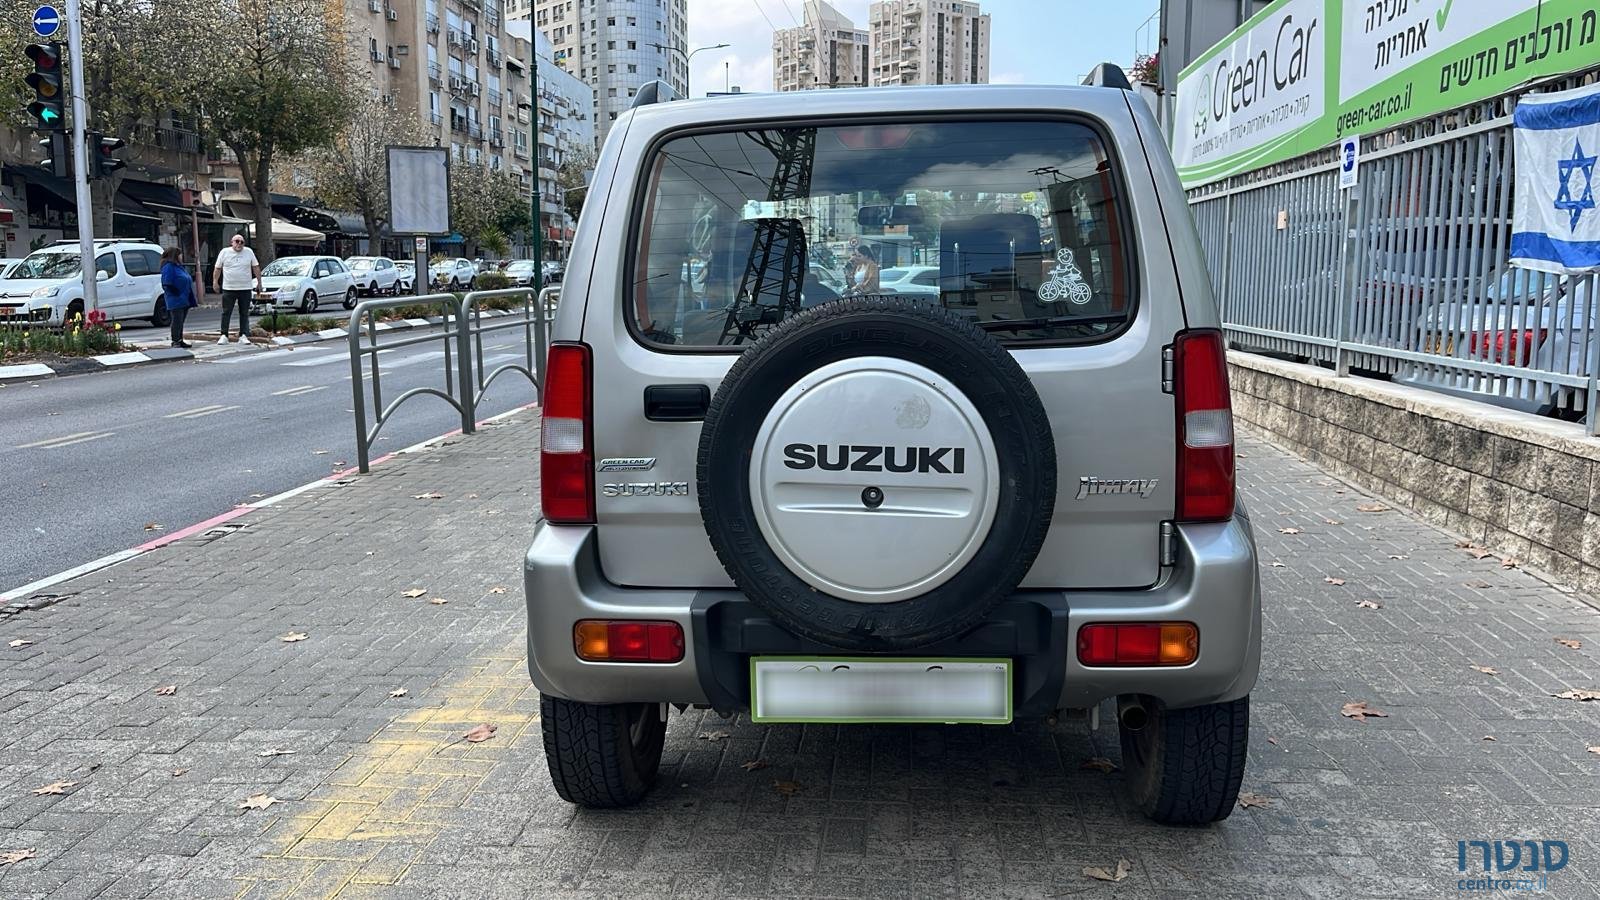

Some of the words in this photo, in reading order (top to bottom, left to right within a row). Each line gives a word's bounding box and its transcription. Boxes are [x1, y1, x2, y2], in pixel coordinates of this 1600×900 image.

[1213, 49, 1268, 122] Green
[1273, 14, 1317, 91] Car
[1374, 18, 1430, 70] אחריות
[1439, 46, 1499, 94] חדשים
[1503, 17, 1573, 72] ורכבים
[1336, 82, 1413, 139] green-car.co.il
[783, 442, 965, 474] SUZUKI
[602, 481, 689, 498] SUZUKI
